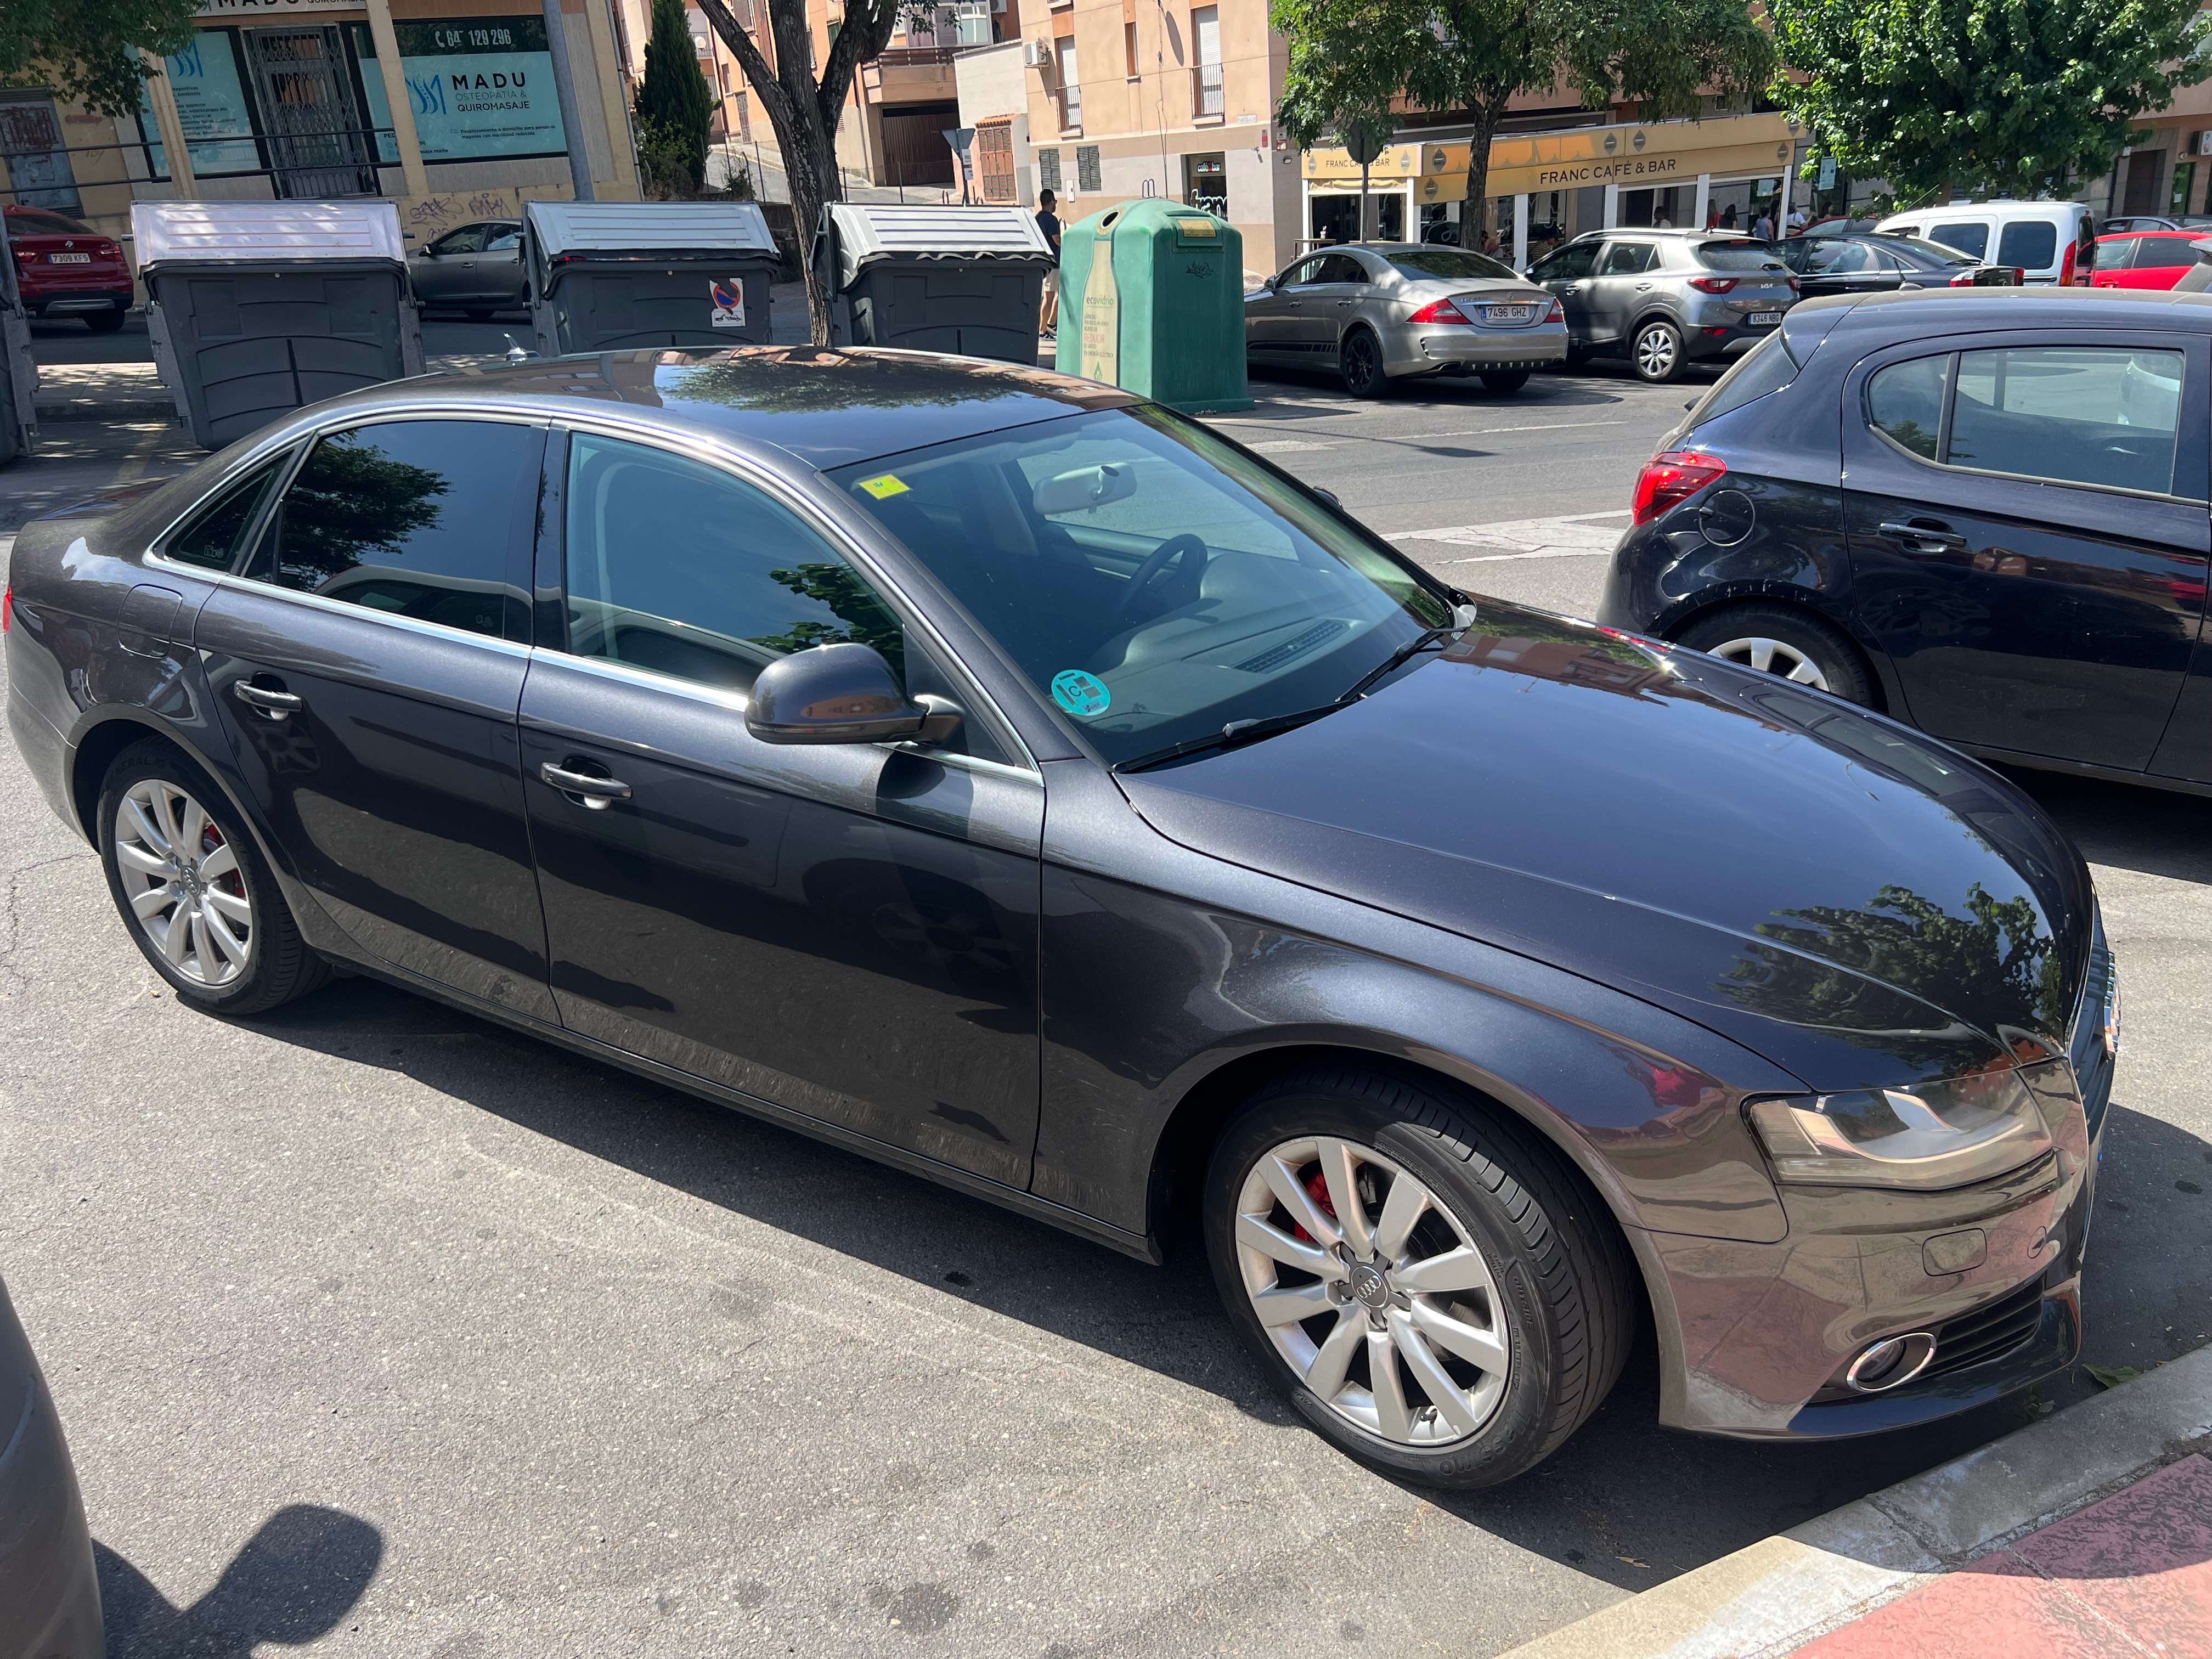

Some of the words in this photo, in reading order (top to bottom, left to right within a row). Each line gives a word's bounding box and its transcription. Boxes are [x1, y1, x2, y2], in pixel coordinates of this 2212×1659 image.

[469, 30, 489, 46] 129
[490, 29, 511, 45] 296
[452, 72, 526, 90] MADU
[455, 89, 517, 101] OSTEOPATÍA
[458, 101, 530, 112] QUIROMASAJE
[1326, 160, 1348, 168] FRANC
[1375, 158, 1390, 166] BAR
[1540, 168, 1589, 184] FRANC
[1593, 160, 1632, 178] CAFÉ
[1635, 162, 1645, 173] &
[1649, 159, 1676, 173] BAR
[53, 255, 72, 263] 7309
[1087, 295, 1114, 306] ecovidrio
[1488, 308, 1508, 318] 7496
[1511, 307, 1527, 317] GHZ
[1068, 686, 1082, 697] C
[1513, 1275, 1534, 1330] OUTSIDE
